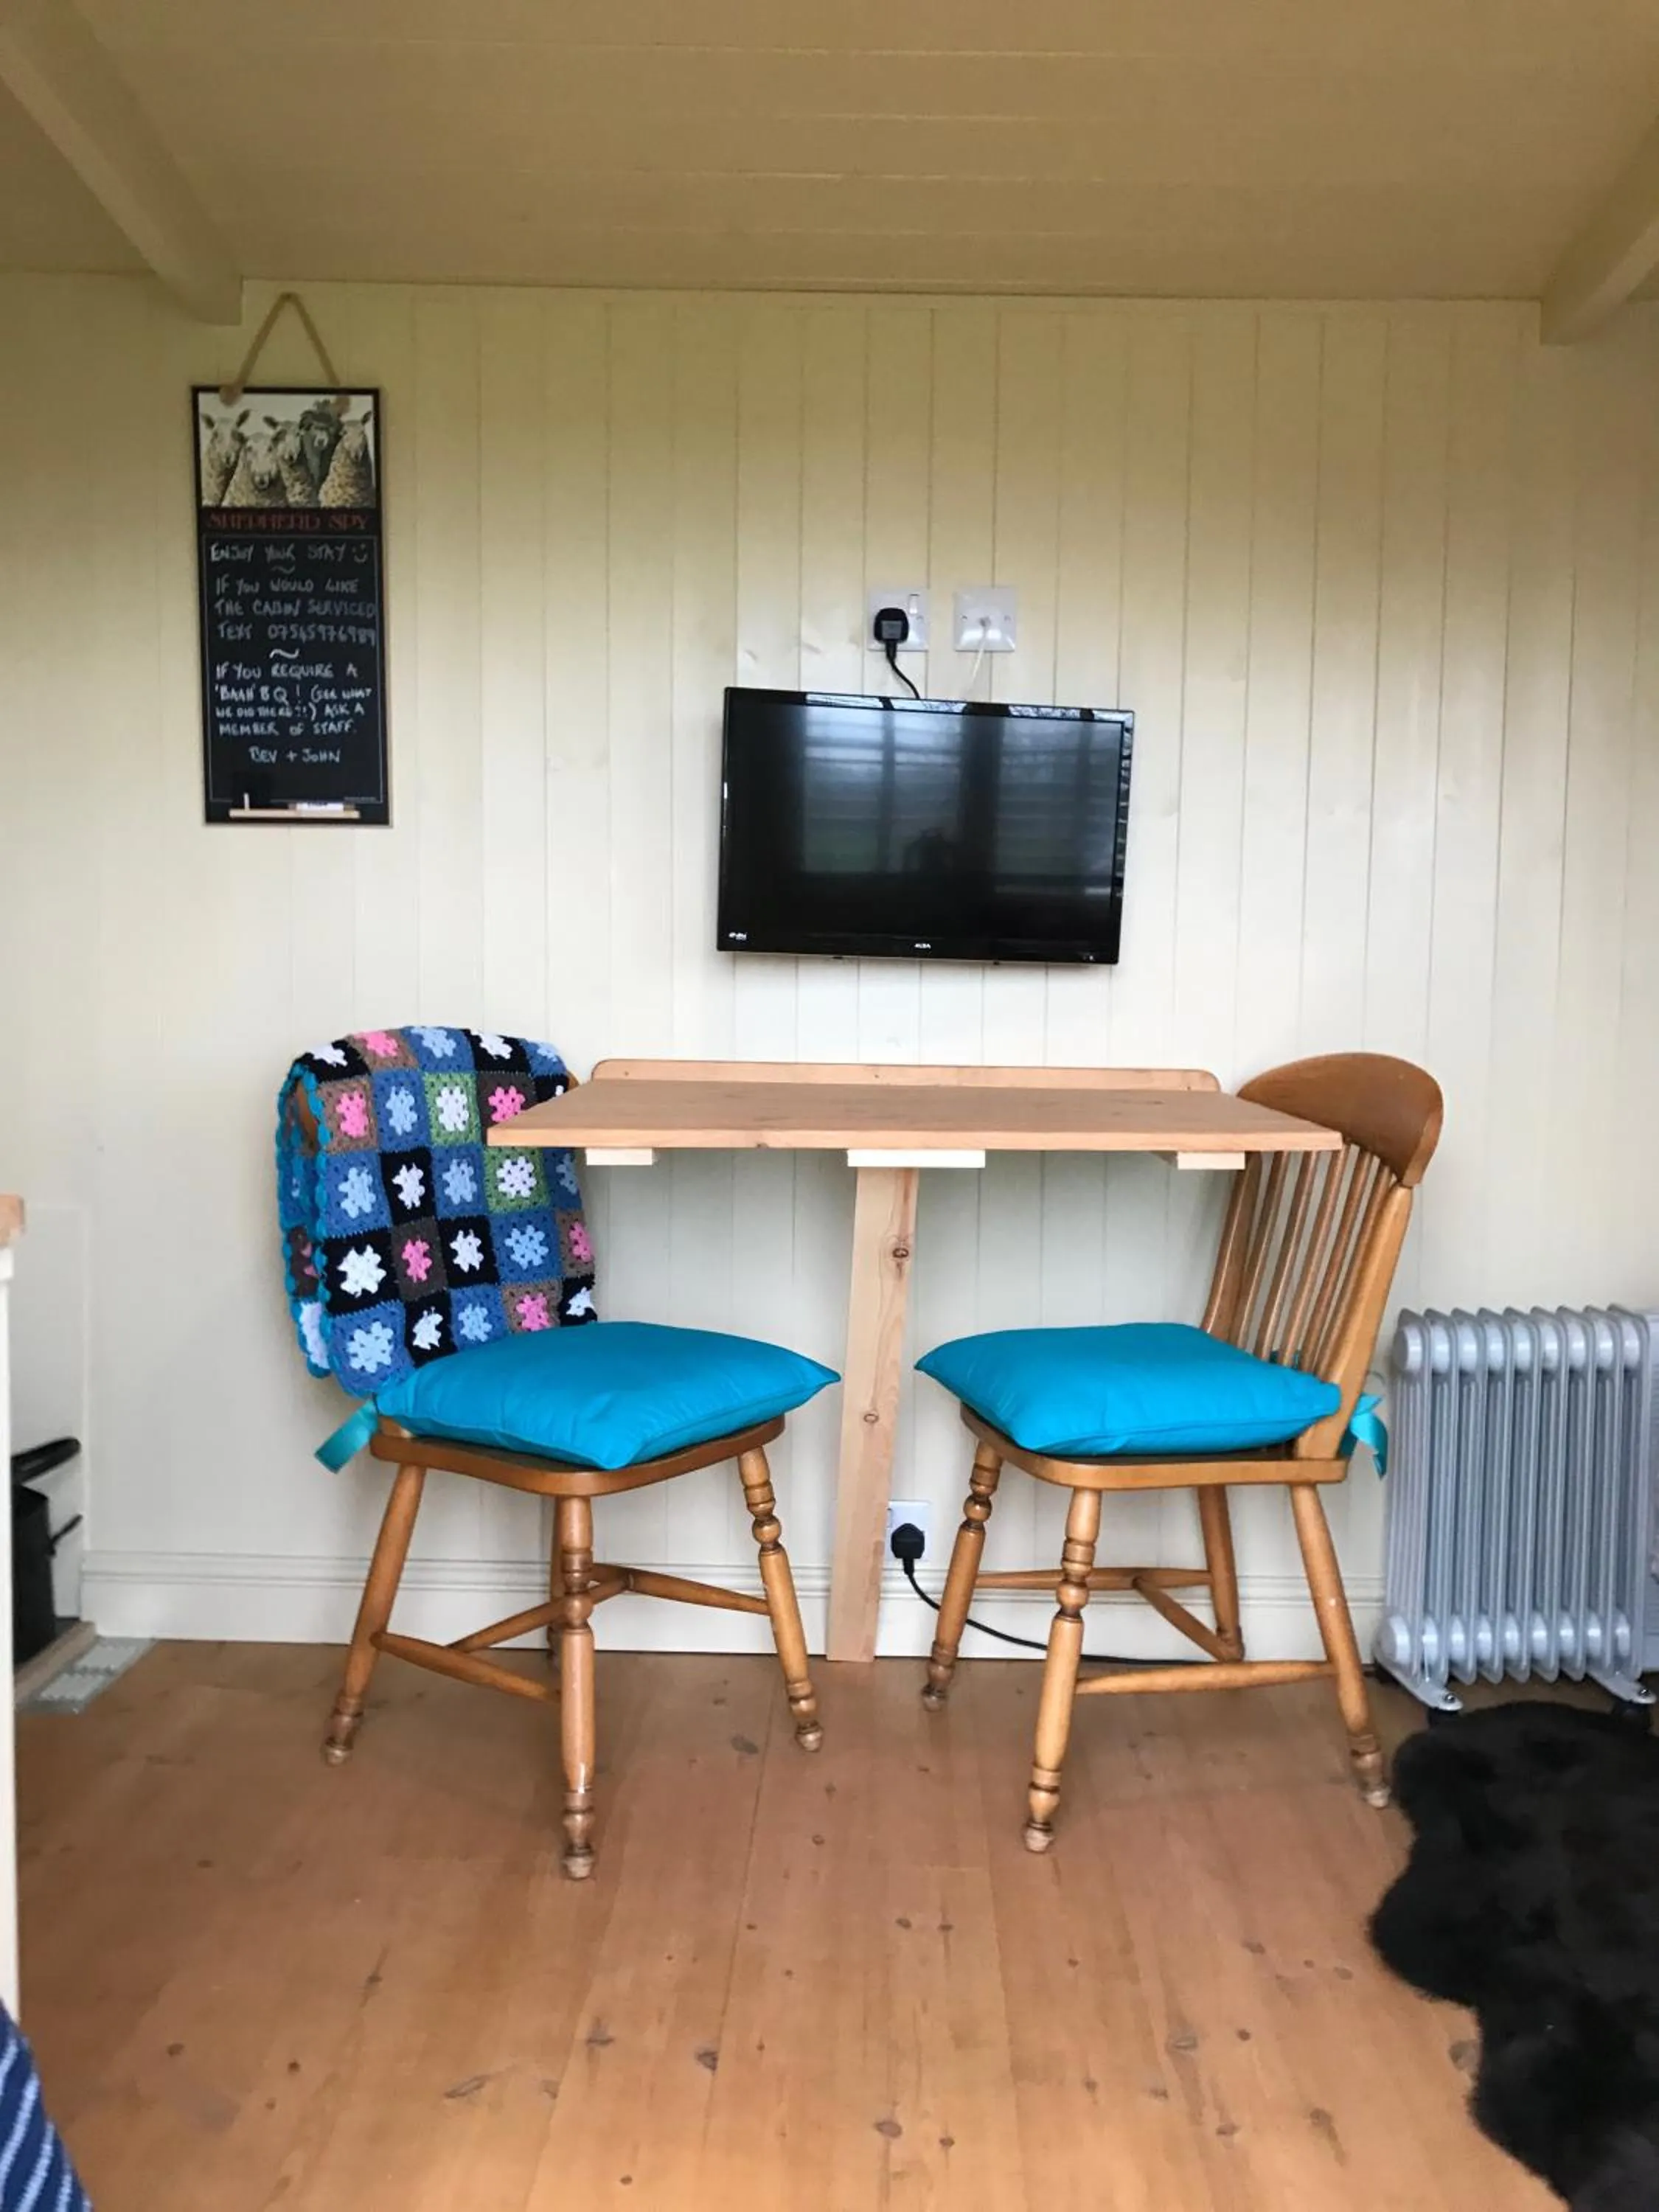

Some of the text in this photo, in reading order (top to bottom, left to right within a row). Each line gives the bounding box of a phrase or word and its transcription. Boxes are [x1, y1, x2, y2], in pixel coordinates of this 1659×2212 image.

[211, 543, 347, 563] ENJOY YOUR STAY
[236, 579, 260, 596] YOU
[270, 579, 314, 592] WOULD
[325, 579, 359, 593] LIKE
[215, 599, 376, 619] THE CABIN SERVICED
[216, 661, 358, 681] IF YOU REQUIRE A
[342, 688, 372, 700] WHAT
[216, 706, 232, 718] WE
[324, 703, 349, 719] ASK
[355, 702, 365, 716] A
[219, 720, 279, 737] MEMBER
[249, 745, 277, 765] BEV
